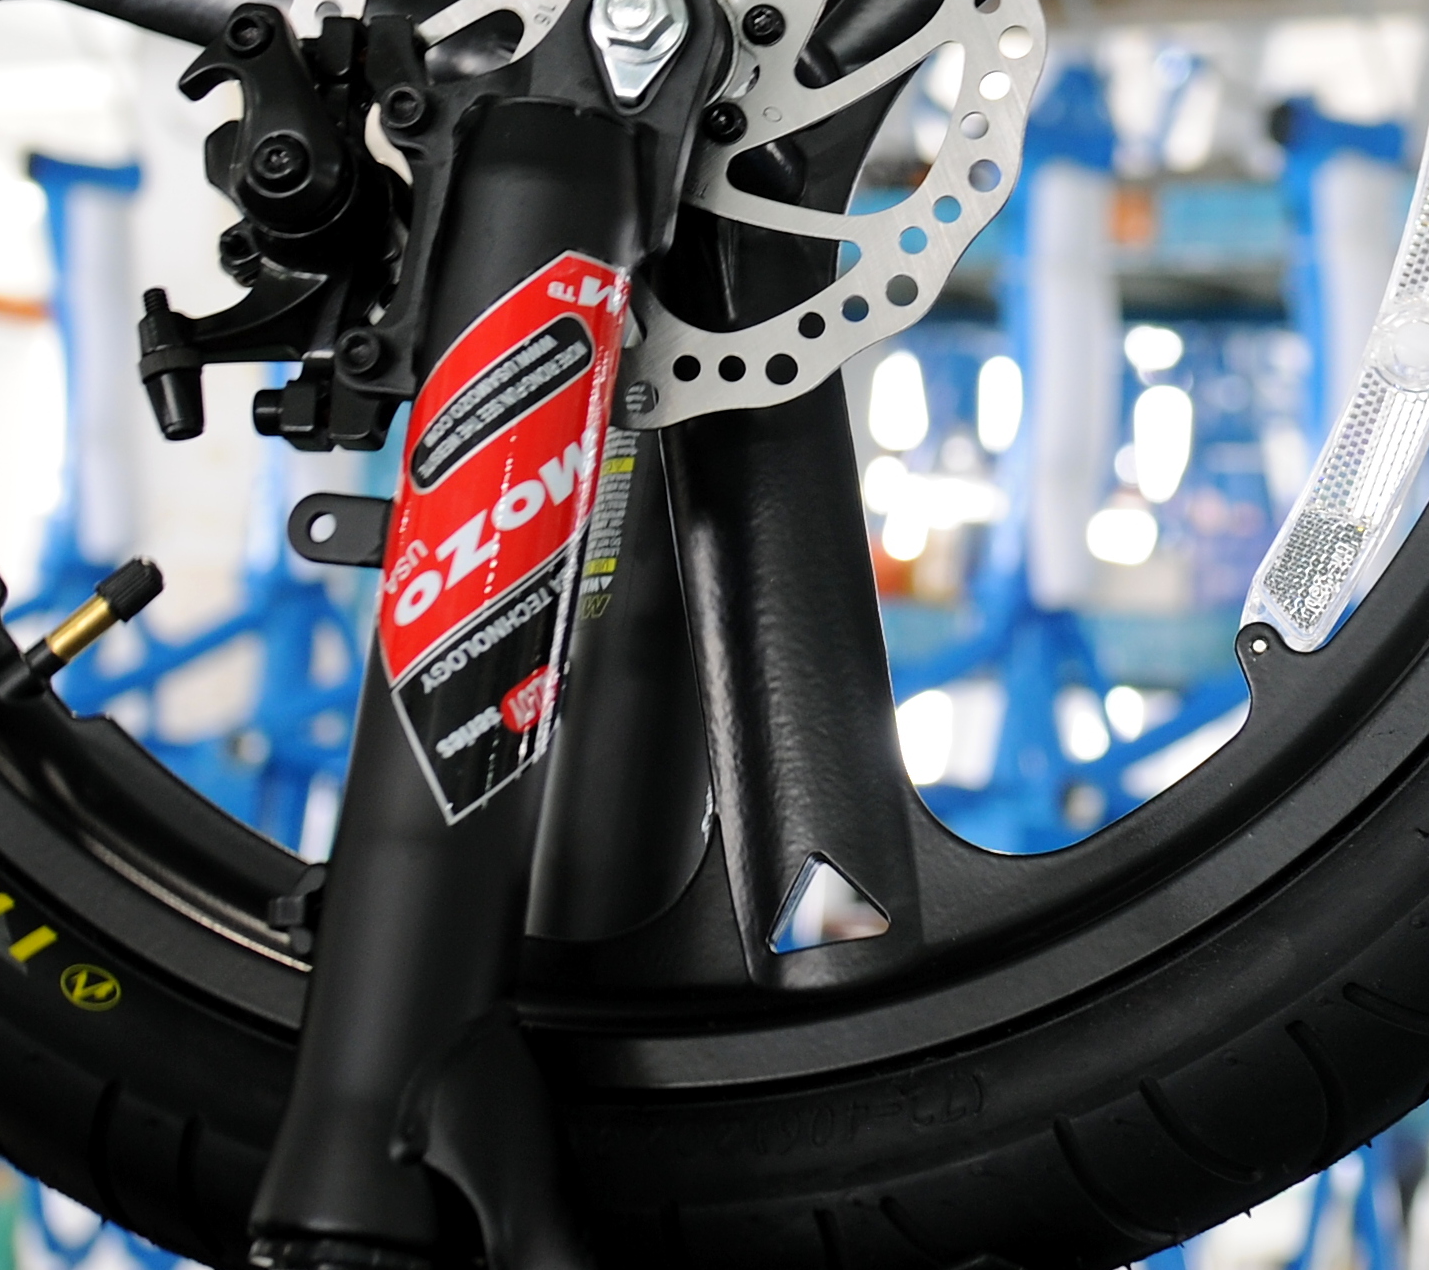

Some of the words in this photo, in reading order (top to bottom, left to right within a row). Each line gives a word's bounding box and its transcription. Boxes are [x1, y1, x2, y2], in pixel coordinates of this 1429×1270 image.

[384, 537, 430, 596] USA
[393, 429, 597, 627] MOZO
[420, 586, 555, 695] TECHNOLOGY
[435, 705, 503, 760] series
